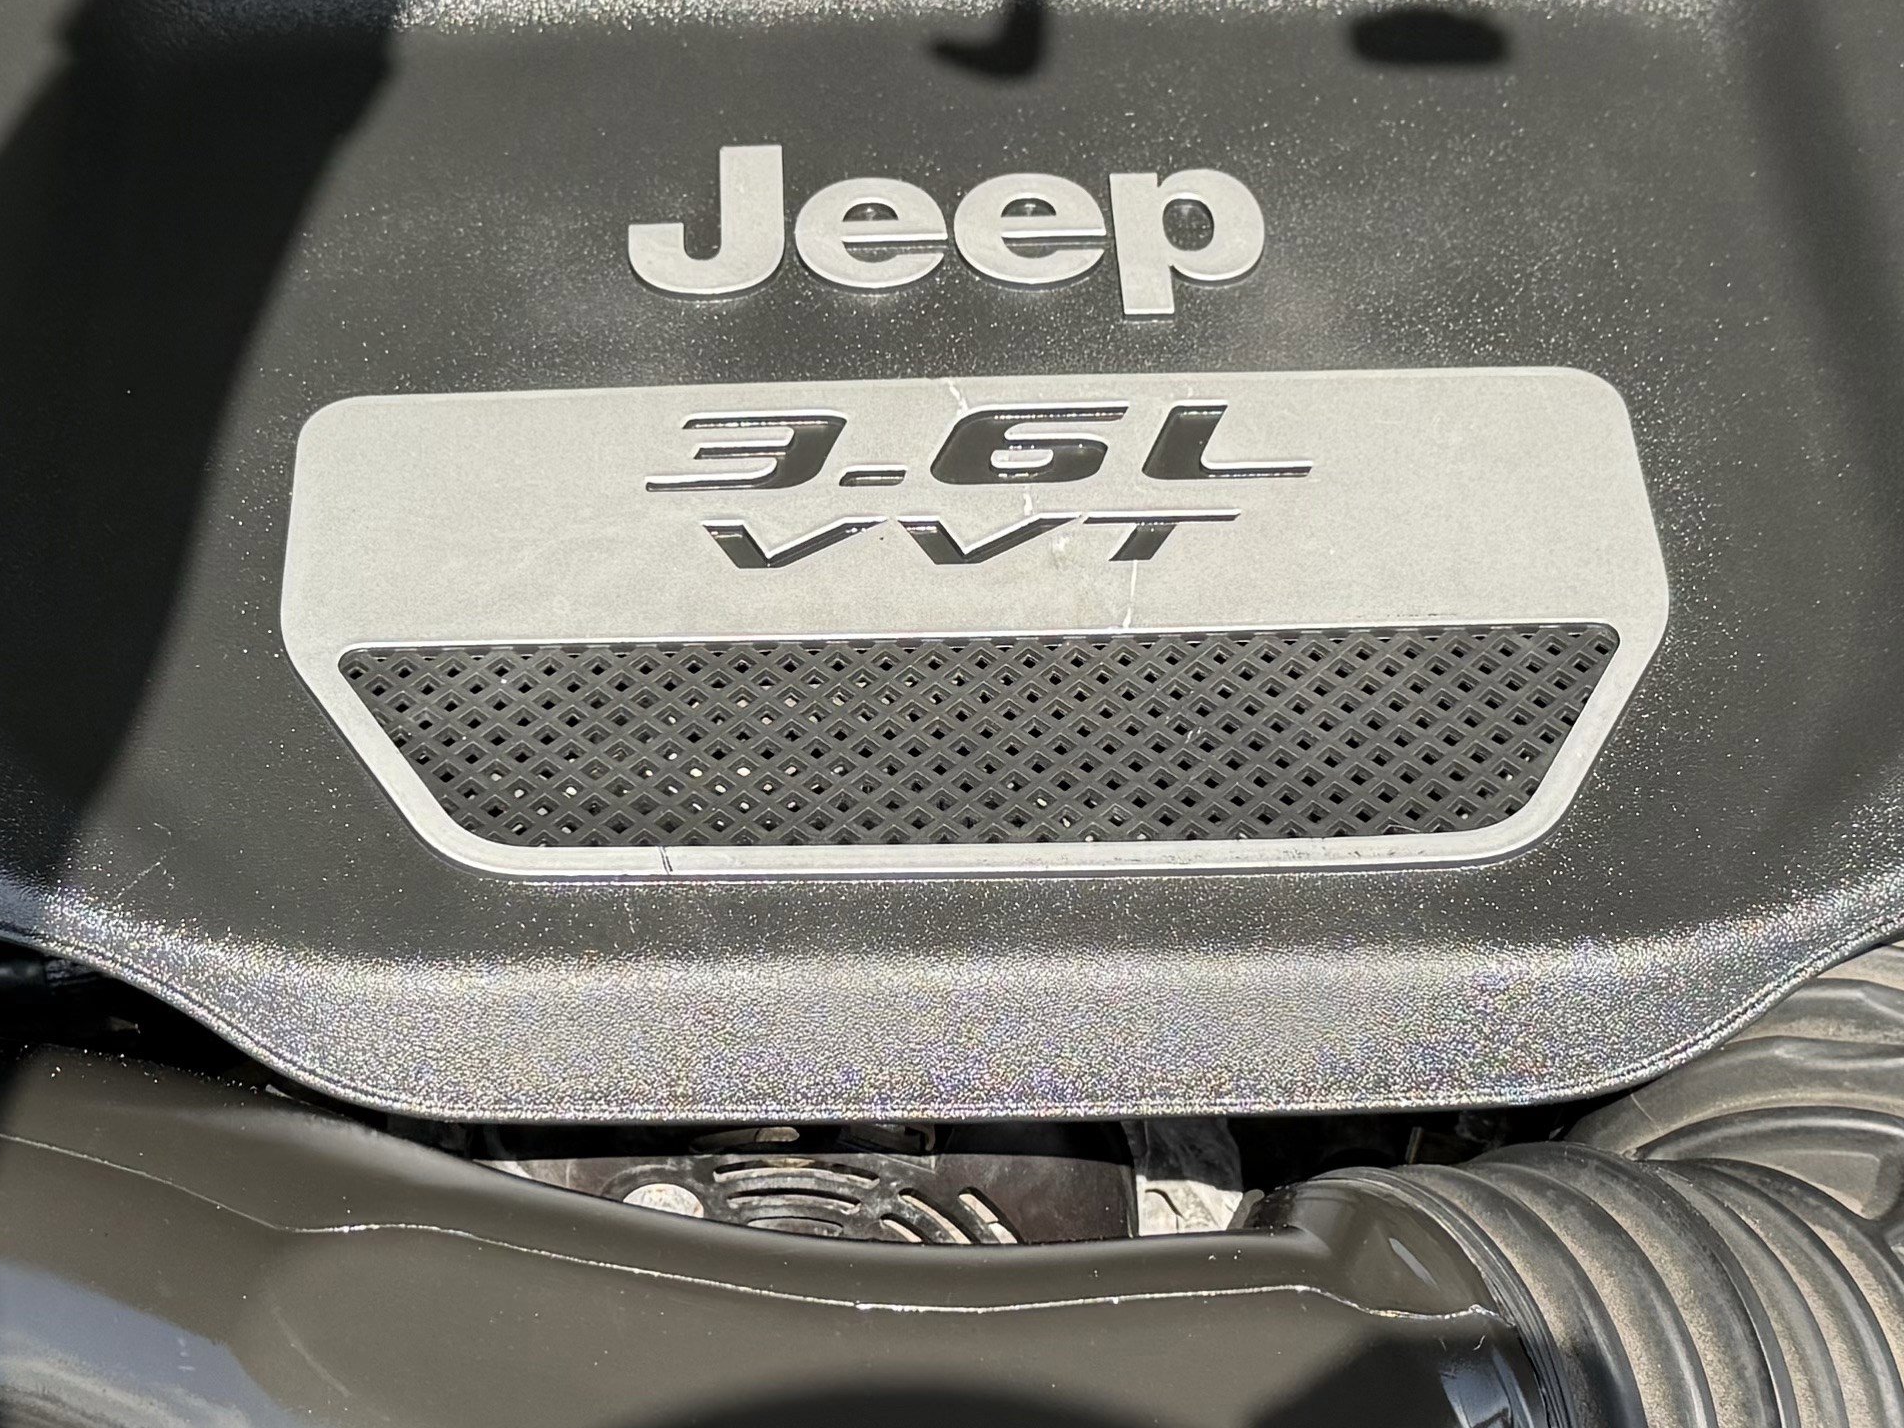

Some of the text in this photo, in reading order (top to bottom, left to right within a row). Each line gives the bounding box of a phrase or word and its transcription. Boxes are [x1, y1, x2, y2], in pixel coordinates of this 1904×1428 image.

[627, 144, 1265, 319] Jeep
[644, 401, 1314, 492] 3.6L
[701, 506, 1241, 570] VVT
